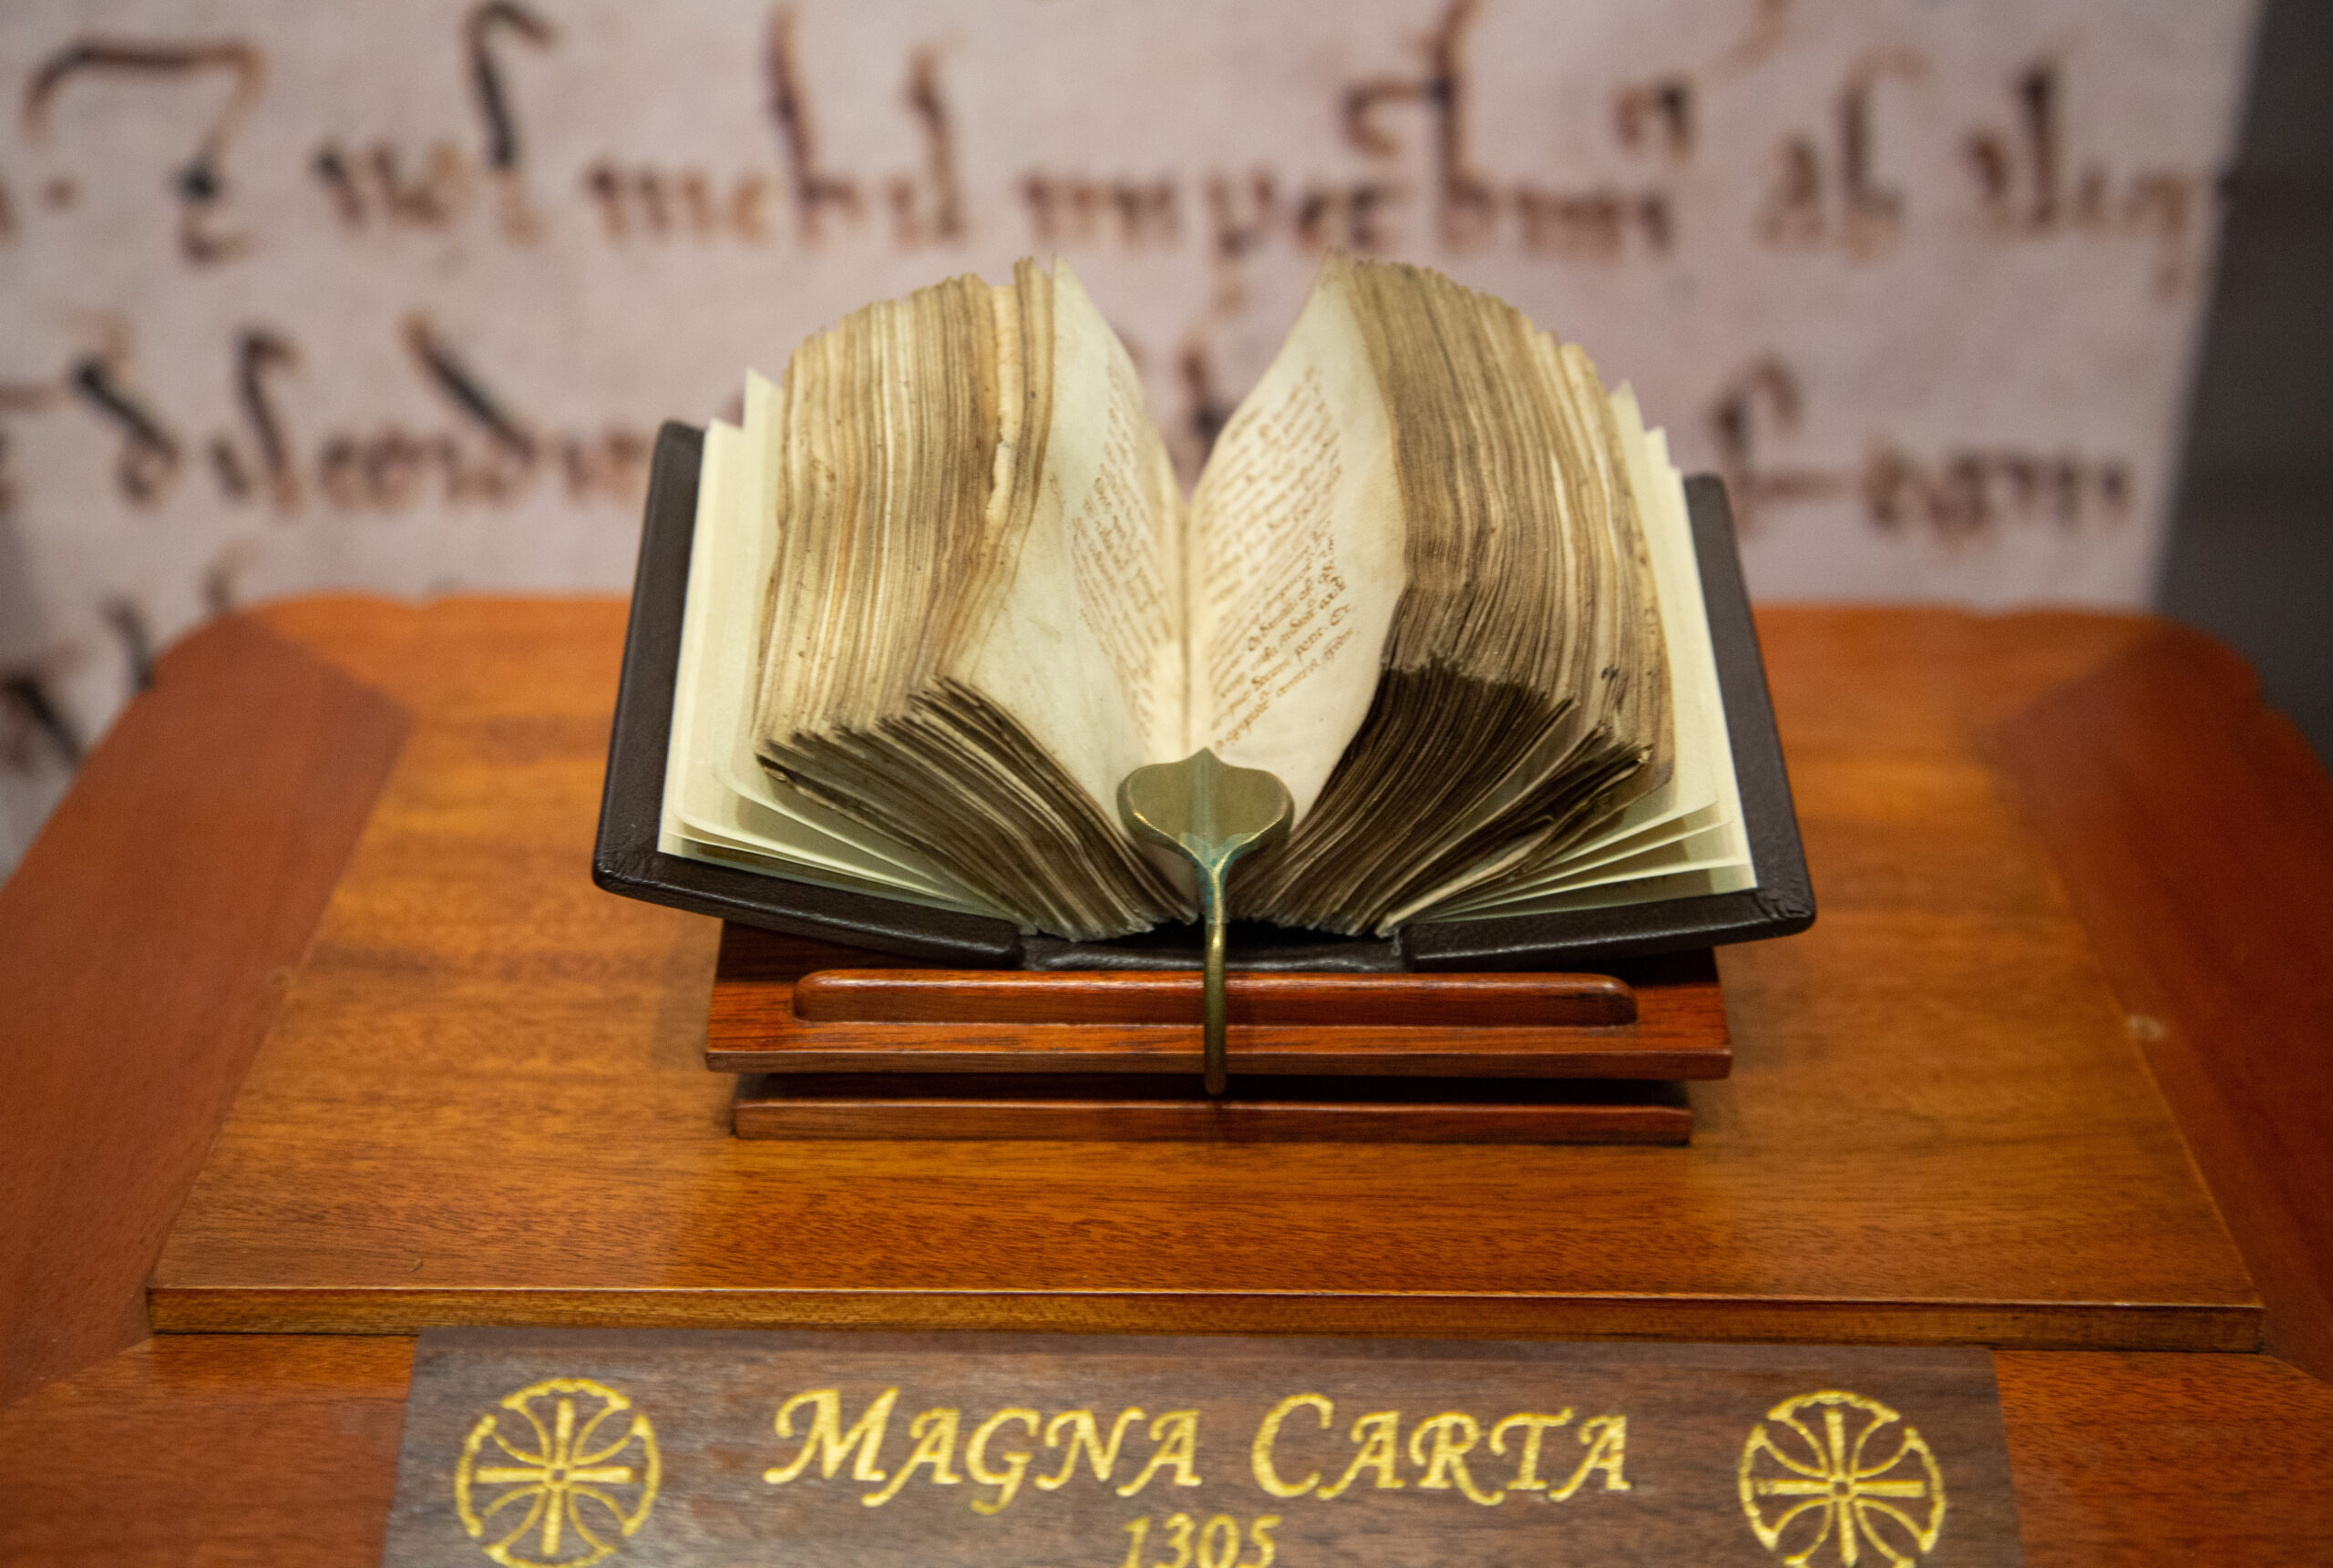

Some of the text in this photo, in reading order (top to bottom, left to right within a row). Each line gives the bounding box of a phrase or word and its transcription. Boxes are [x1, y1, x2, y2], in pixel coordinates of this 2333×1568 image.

[763, 1386, 1632, 1515] MAGNA CARTA
[1118, 1512, 1281, 1568] 1305
